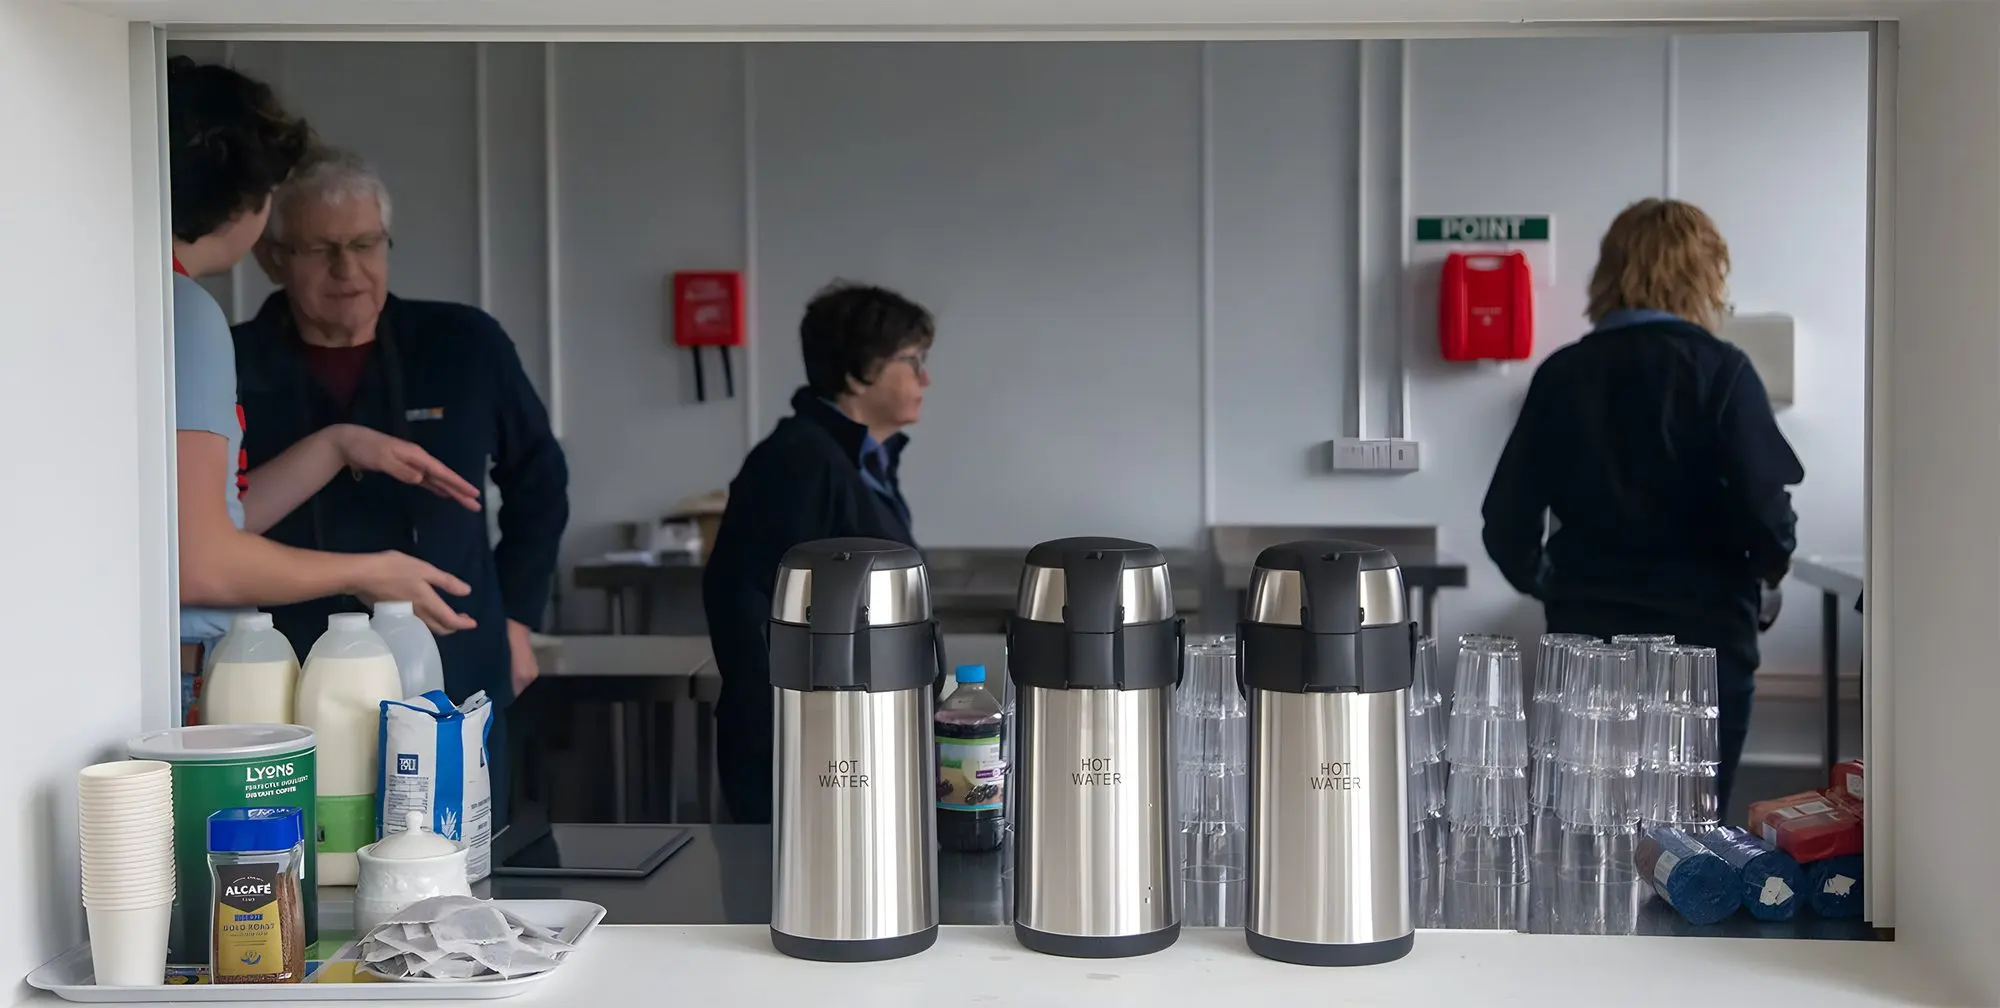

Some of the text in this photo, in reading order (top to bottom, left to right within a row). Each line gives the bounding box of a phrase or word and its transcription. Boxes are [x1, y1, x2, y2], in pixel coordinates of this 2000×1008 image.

[1441, 217, 1525, 240] POINT
[828, 760, 858, 773] HOT
[1081, 758, 1111, 771] HOT
[1320, 762, 1351, 775] HOT
[245, 762, 294, 782] LYONS
[818, 774, 869, 788] WATER
[1072, 773, 1122, 786] WATER
[1310, 777, 1361, 790] WATER
